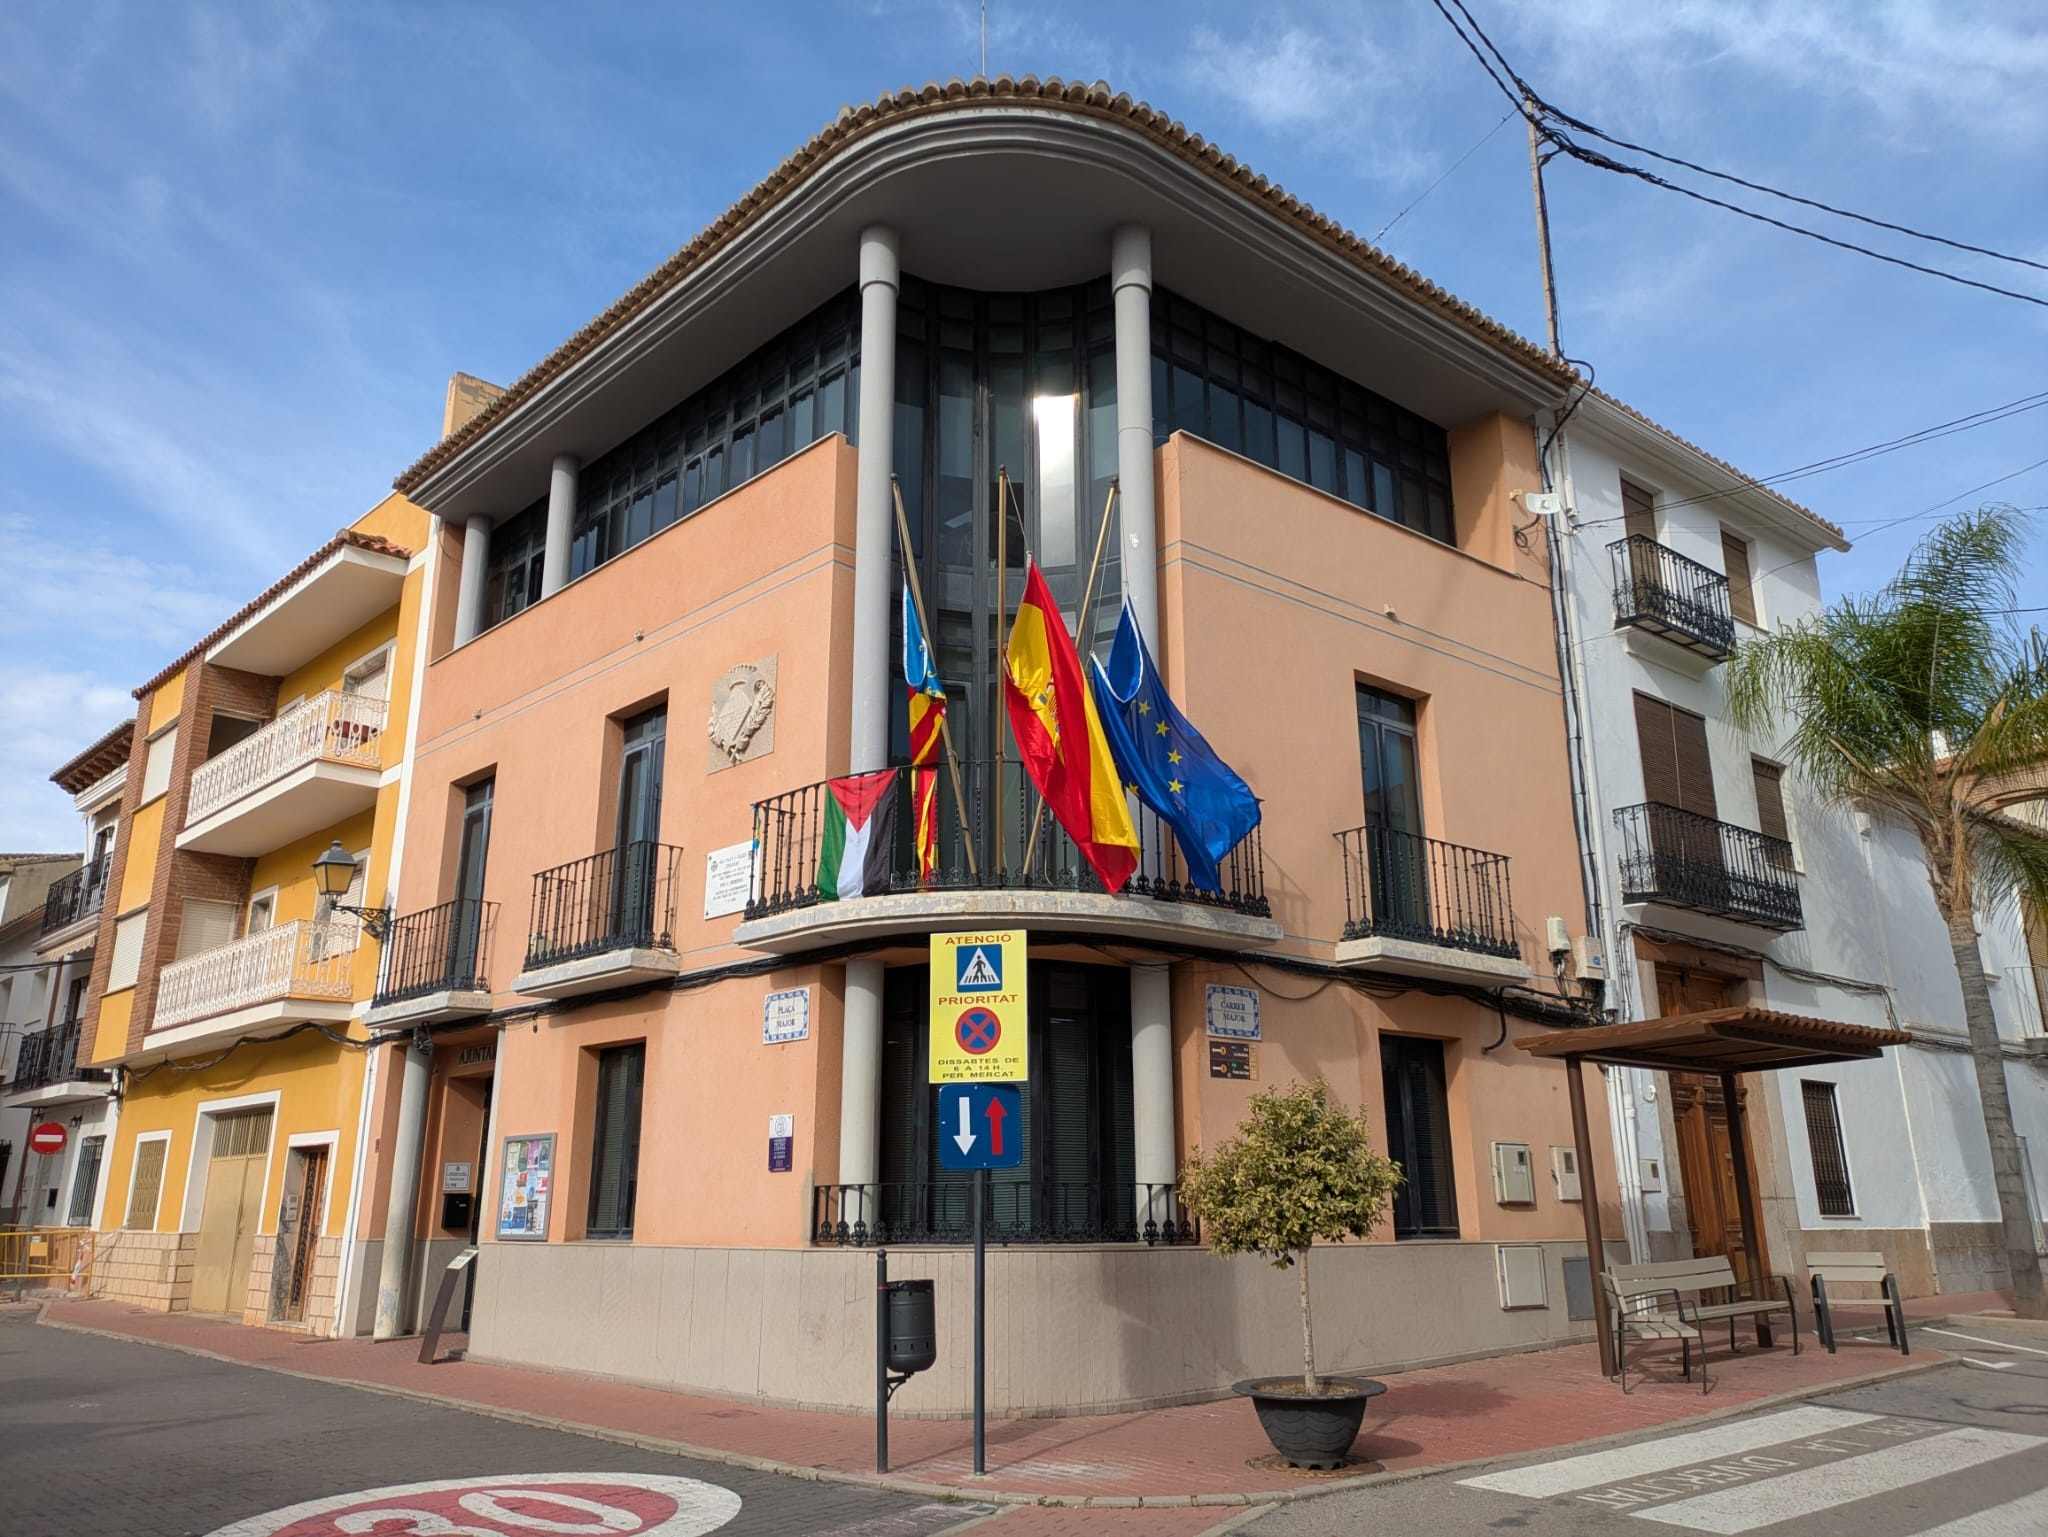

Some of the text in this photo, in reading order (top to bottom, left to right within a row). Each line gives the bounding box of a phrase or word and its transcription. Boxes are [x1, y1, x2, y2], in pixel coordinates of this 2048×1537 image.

[945, 932, 1012, 945] ATENCIÓ
[938, 994, 1019, 1006] PRIORITAT
[938, 1058, 999, 1066] DISSABTES
[1791, 1438, 1870, 1453] LA
